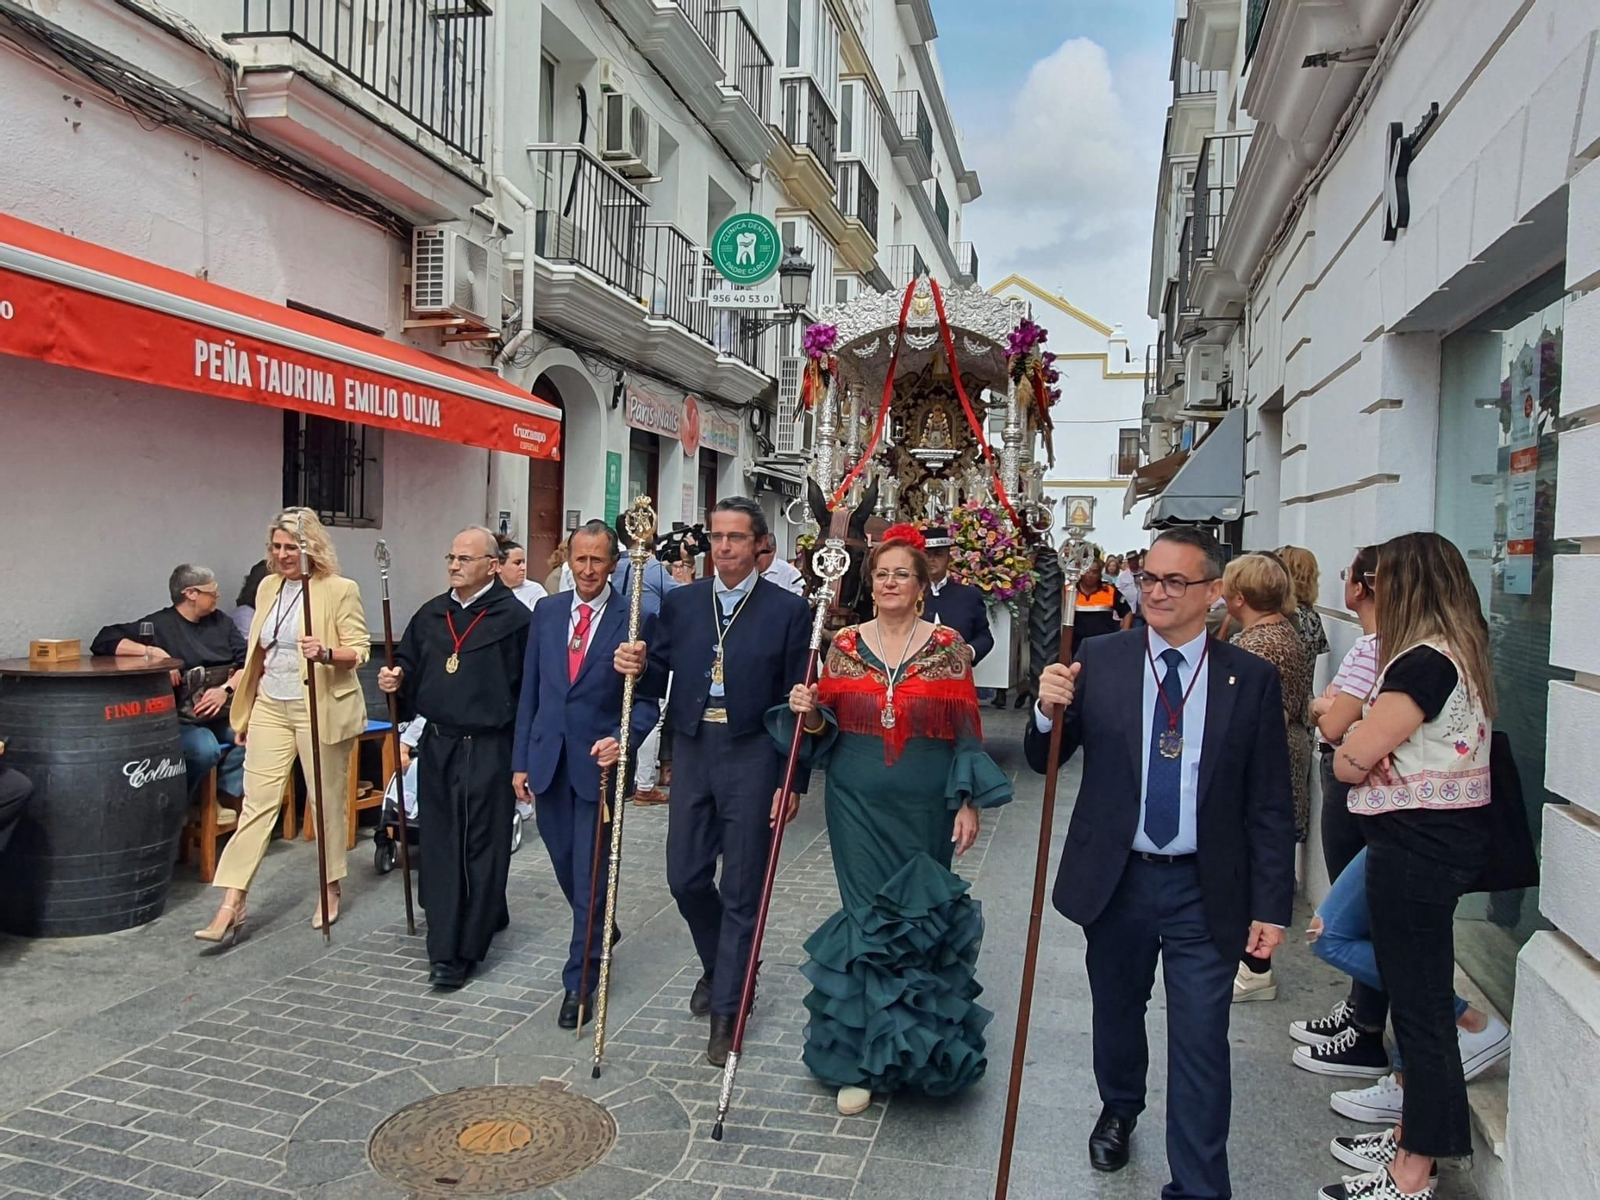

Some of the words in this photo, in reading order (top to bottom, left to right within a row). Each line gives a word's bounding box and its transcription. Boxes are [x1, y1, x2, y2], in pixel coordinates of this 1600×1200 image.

[748, 222, 770, 241] DENTAL
[726, 261, 747, 274] PADRE
[748, 261, 766, 274] CARO
[713, 294, 731, 303] 956
[733, 294, 746, 303] 40
[748, 294, 760, 303] 53
[763, 295, 774, 303] 01
[195, 339, 252, 387] PEÑA
[257, 355, 335, 406] TAURINA
[345, 378, 398, 419] EMILIO
[402, 392, 441, 427] OLIVA
[630, 396, 655, 425] Paris
[656, 405, 679, 432] Nails
[513, 423, 546, 443] Cruzcampo
[105, 701, 141, 720] FINO
